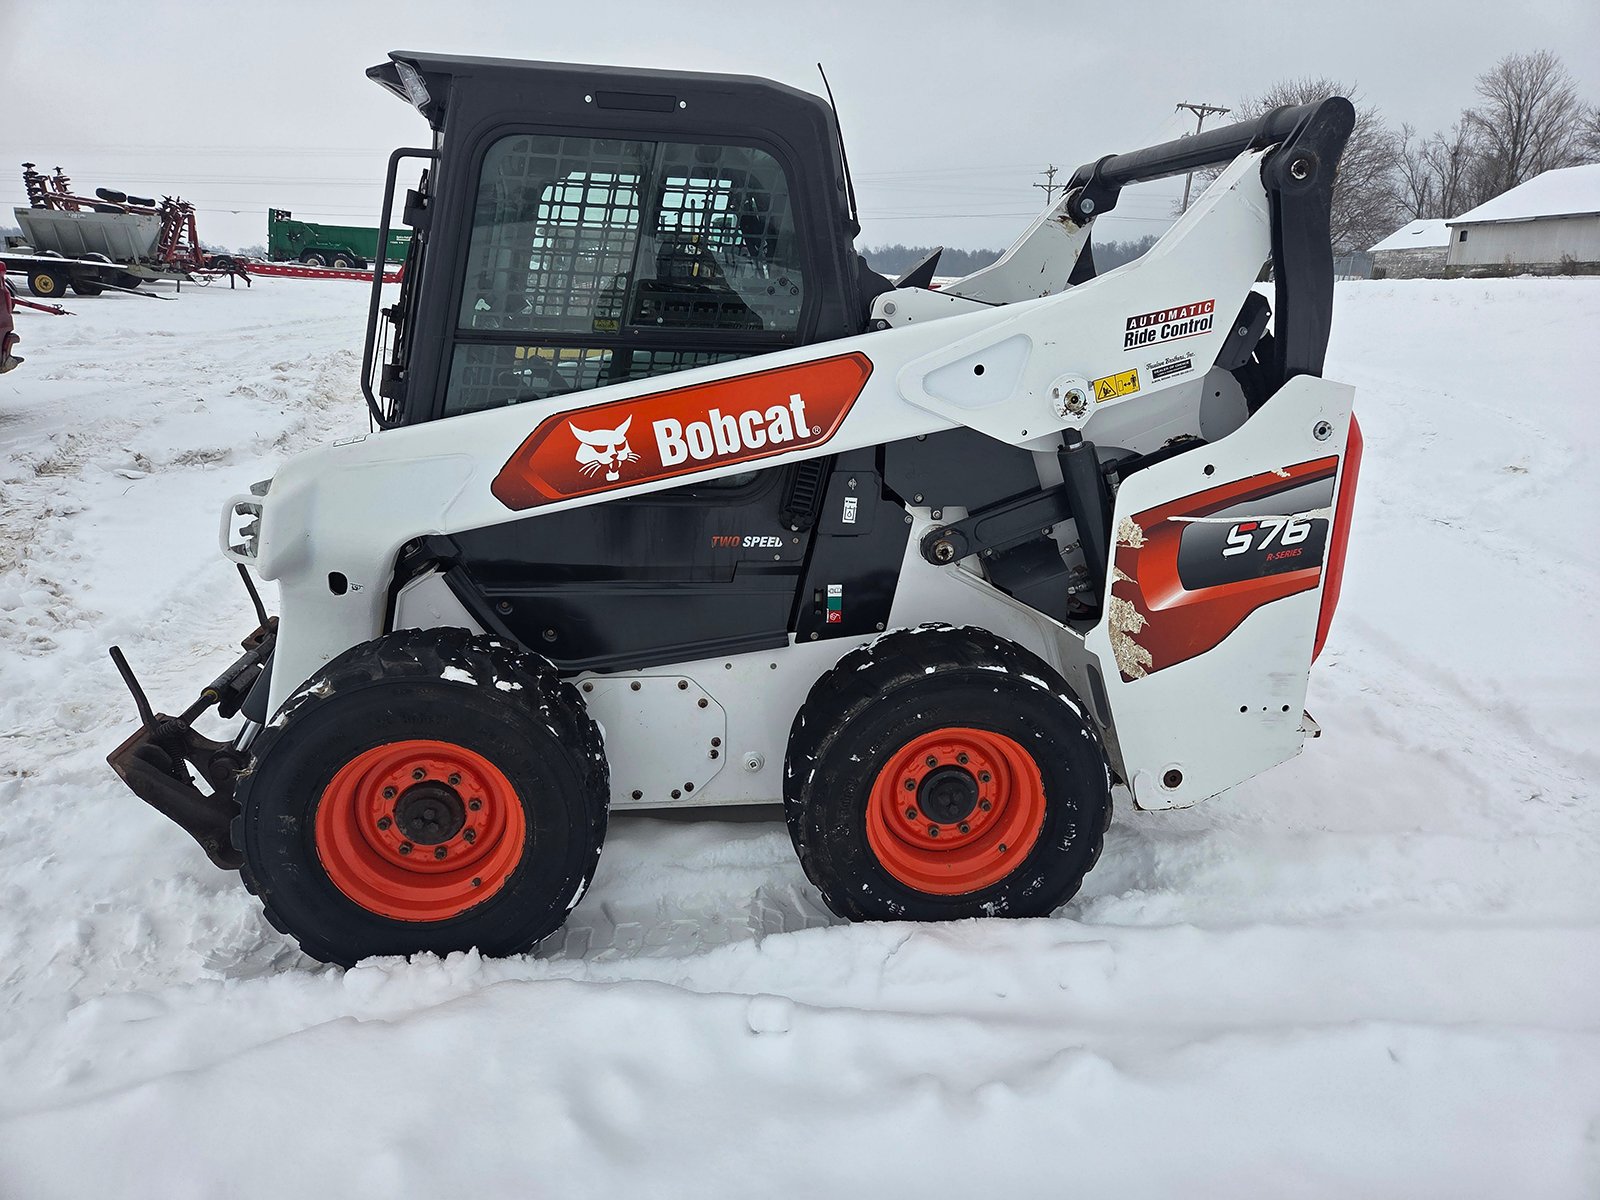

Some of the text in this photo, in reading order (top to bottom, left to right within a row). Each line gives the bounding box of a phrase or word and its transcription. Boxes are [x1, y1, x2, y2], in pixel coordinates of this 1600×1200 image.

[1123, 314, 1214, 348] Ride Control
[1128, 302, 1212, 330] AUTOMATIC
[652, 393, 810, 467] Bobcat
[712, 536, 783, 548] TWO SPEED
[1222, 515, 1312, 556] S76
[1266, 547, 1303, 561] R-SERIES
